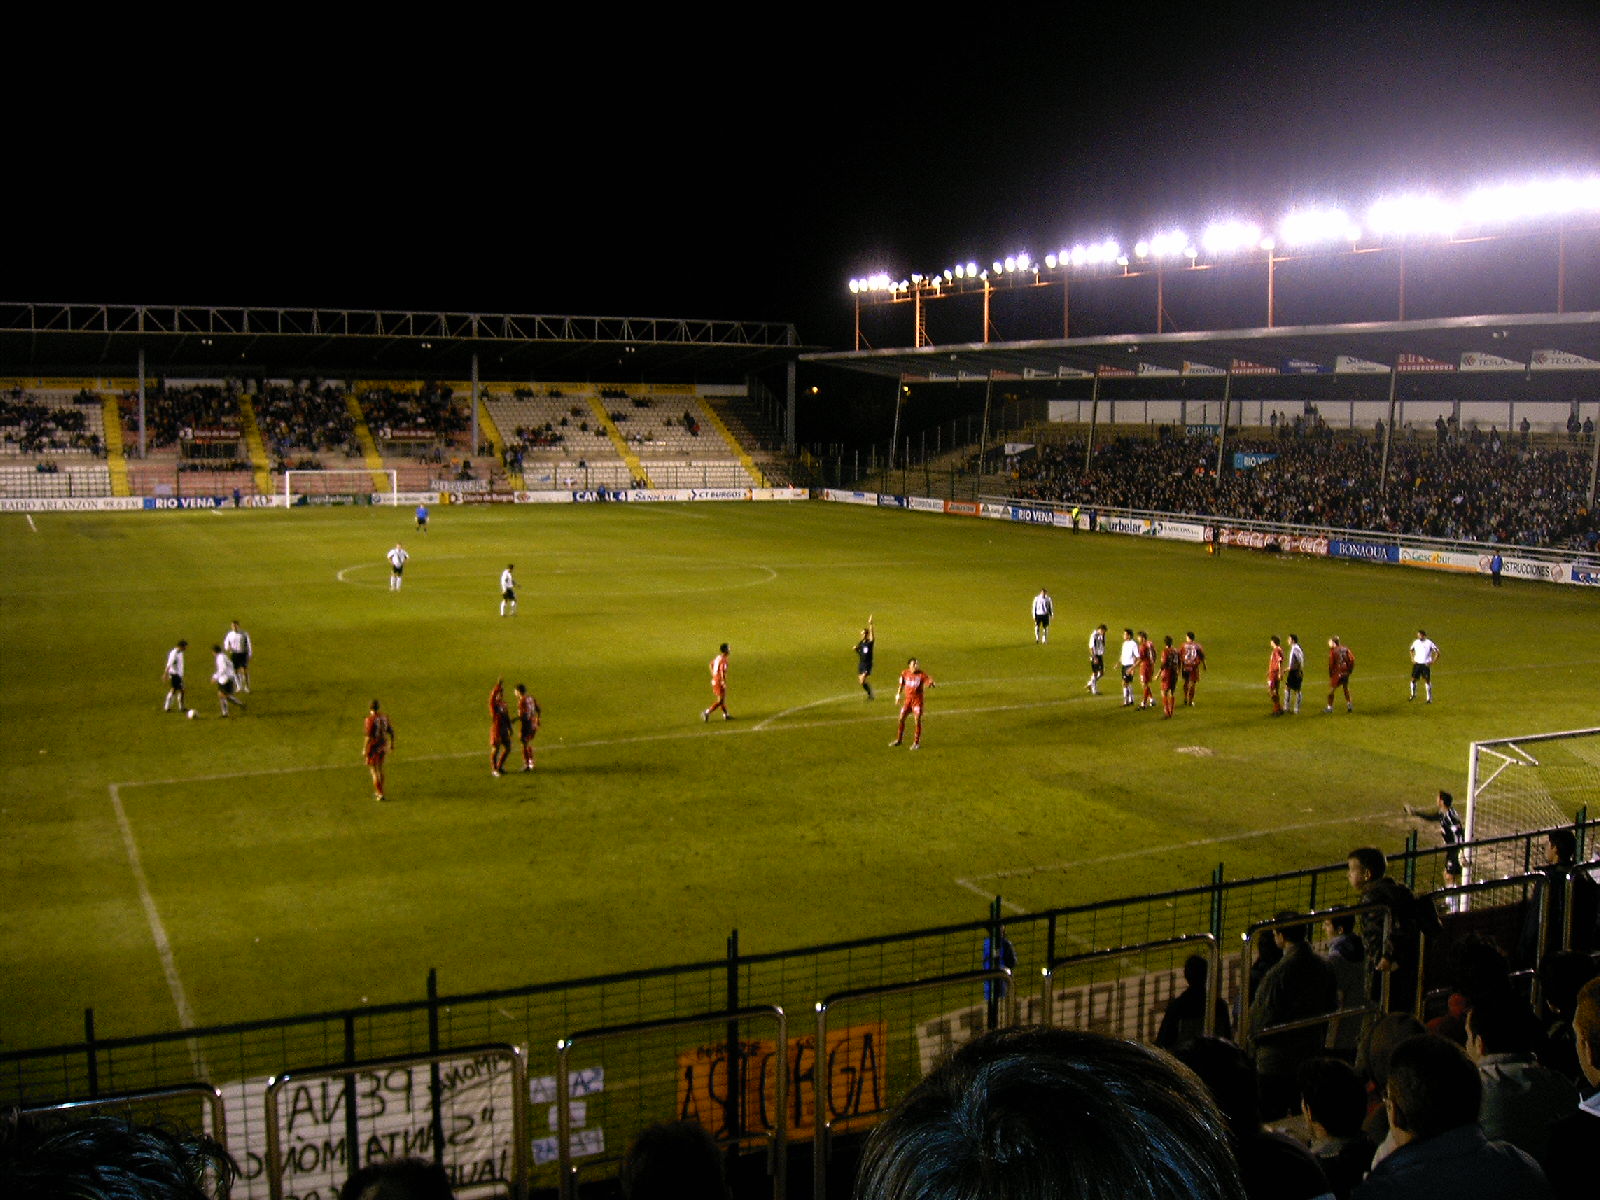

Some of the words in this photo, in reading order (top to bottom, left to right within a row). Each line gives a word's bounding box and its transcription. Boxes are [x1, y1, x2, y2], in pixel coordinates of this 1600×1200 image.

[155, 498, 178, 509] RIO
[180, 498, 216, 508] VENA
[1018, 509, 1032, 521] RIO
[1032, 510, 1054, 523] VENA
[1339, 542, 1389, 560] BONAQUA
